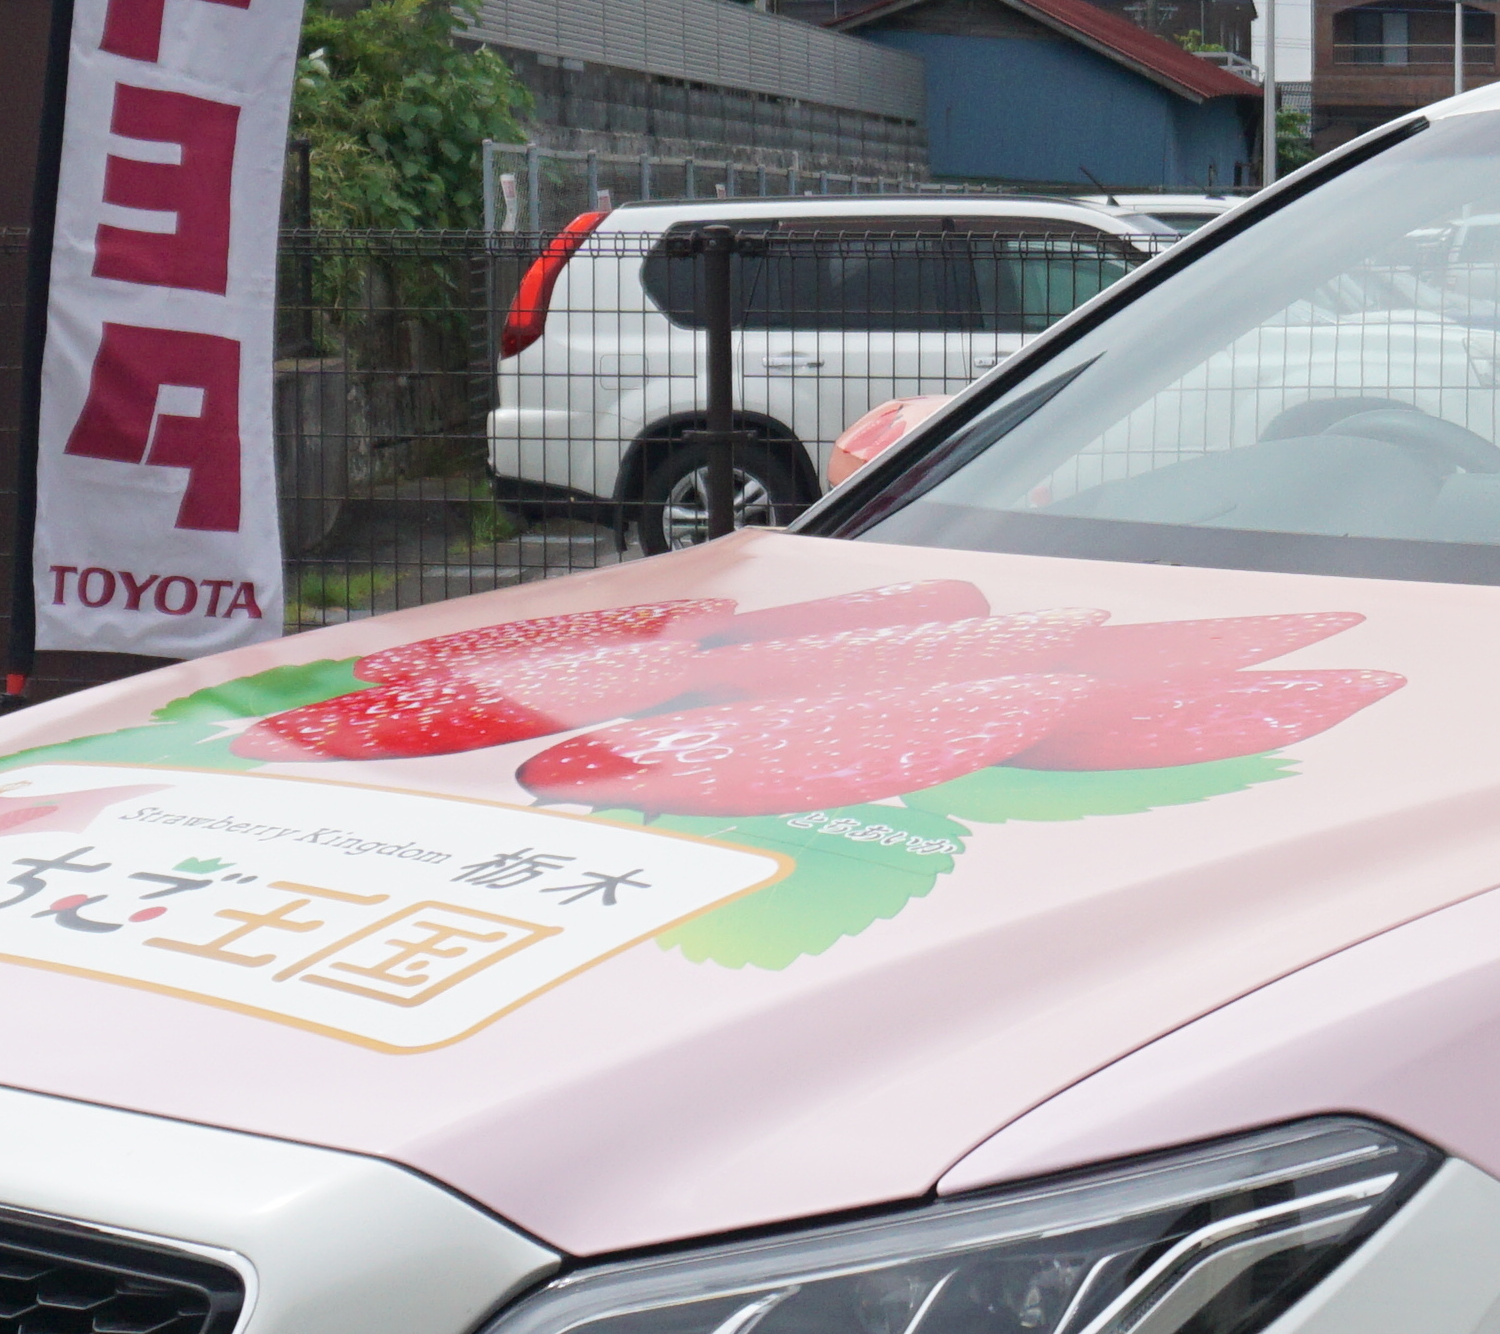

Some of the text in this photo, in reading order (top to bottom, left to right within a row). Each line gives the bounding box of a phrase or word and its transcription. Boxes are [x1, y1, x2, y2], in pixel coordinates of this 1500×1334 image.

[50, 565, 262, 619] TOYOTA
[119, 805, 652, 907] Strawberry Kingdom 栃木
[787, 811, 957, 854] とちあいか
